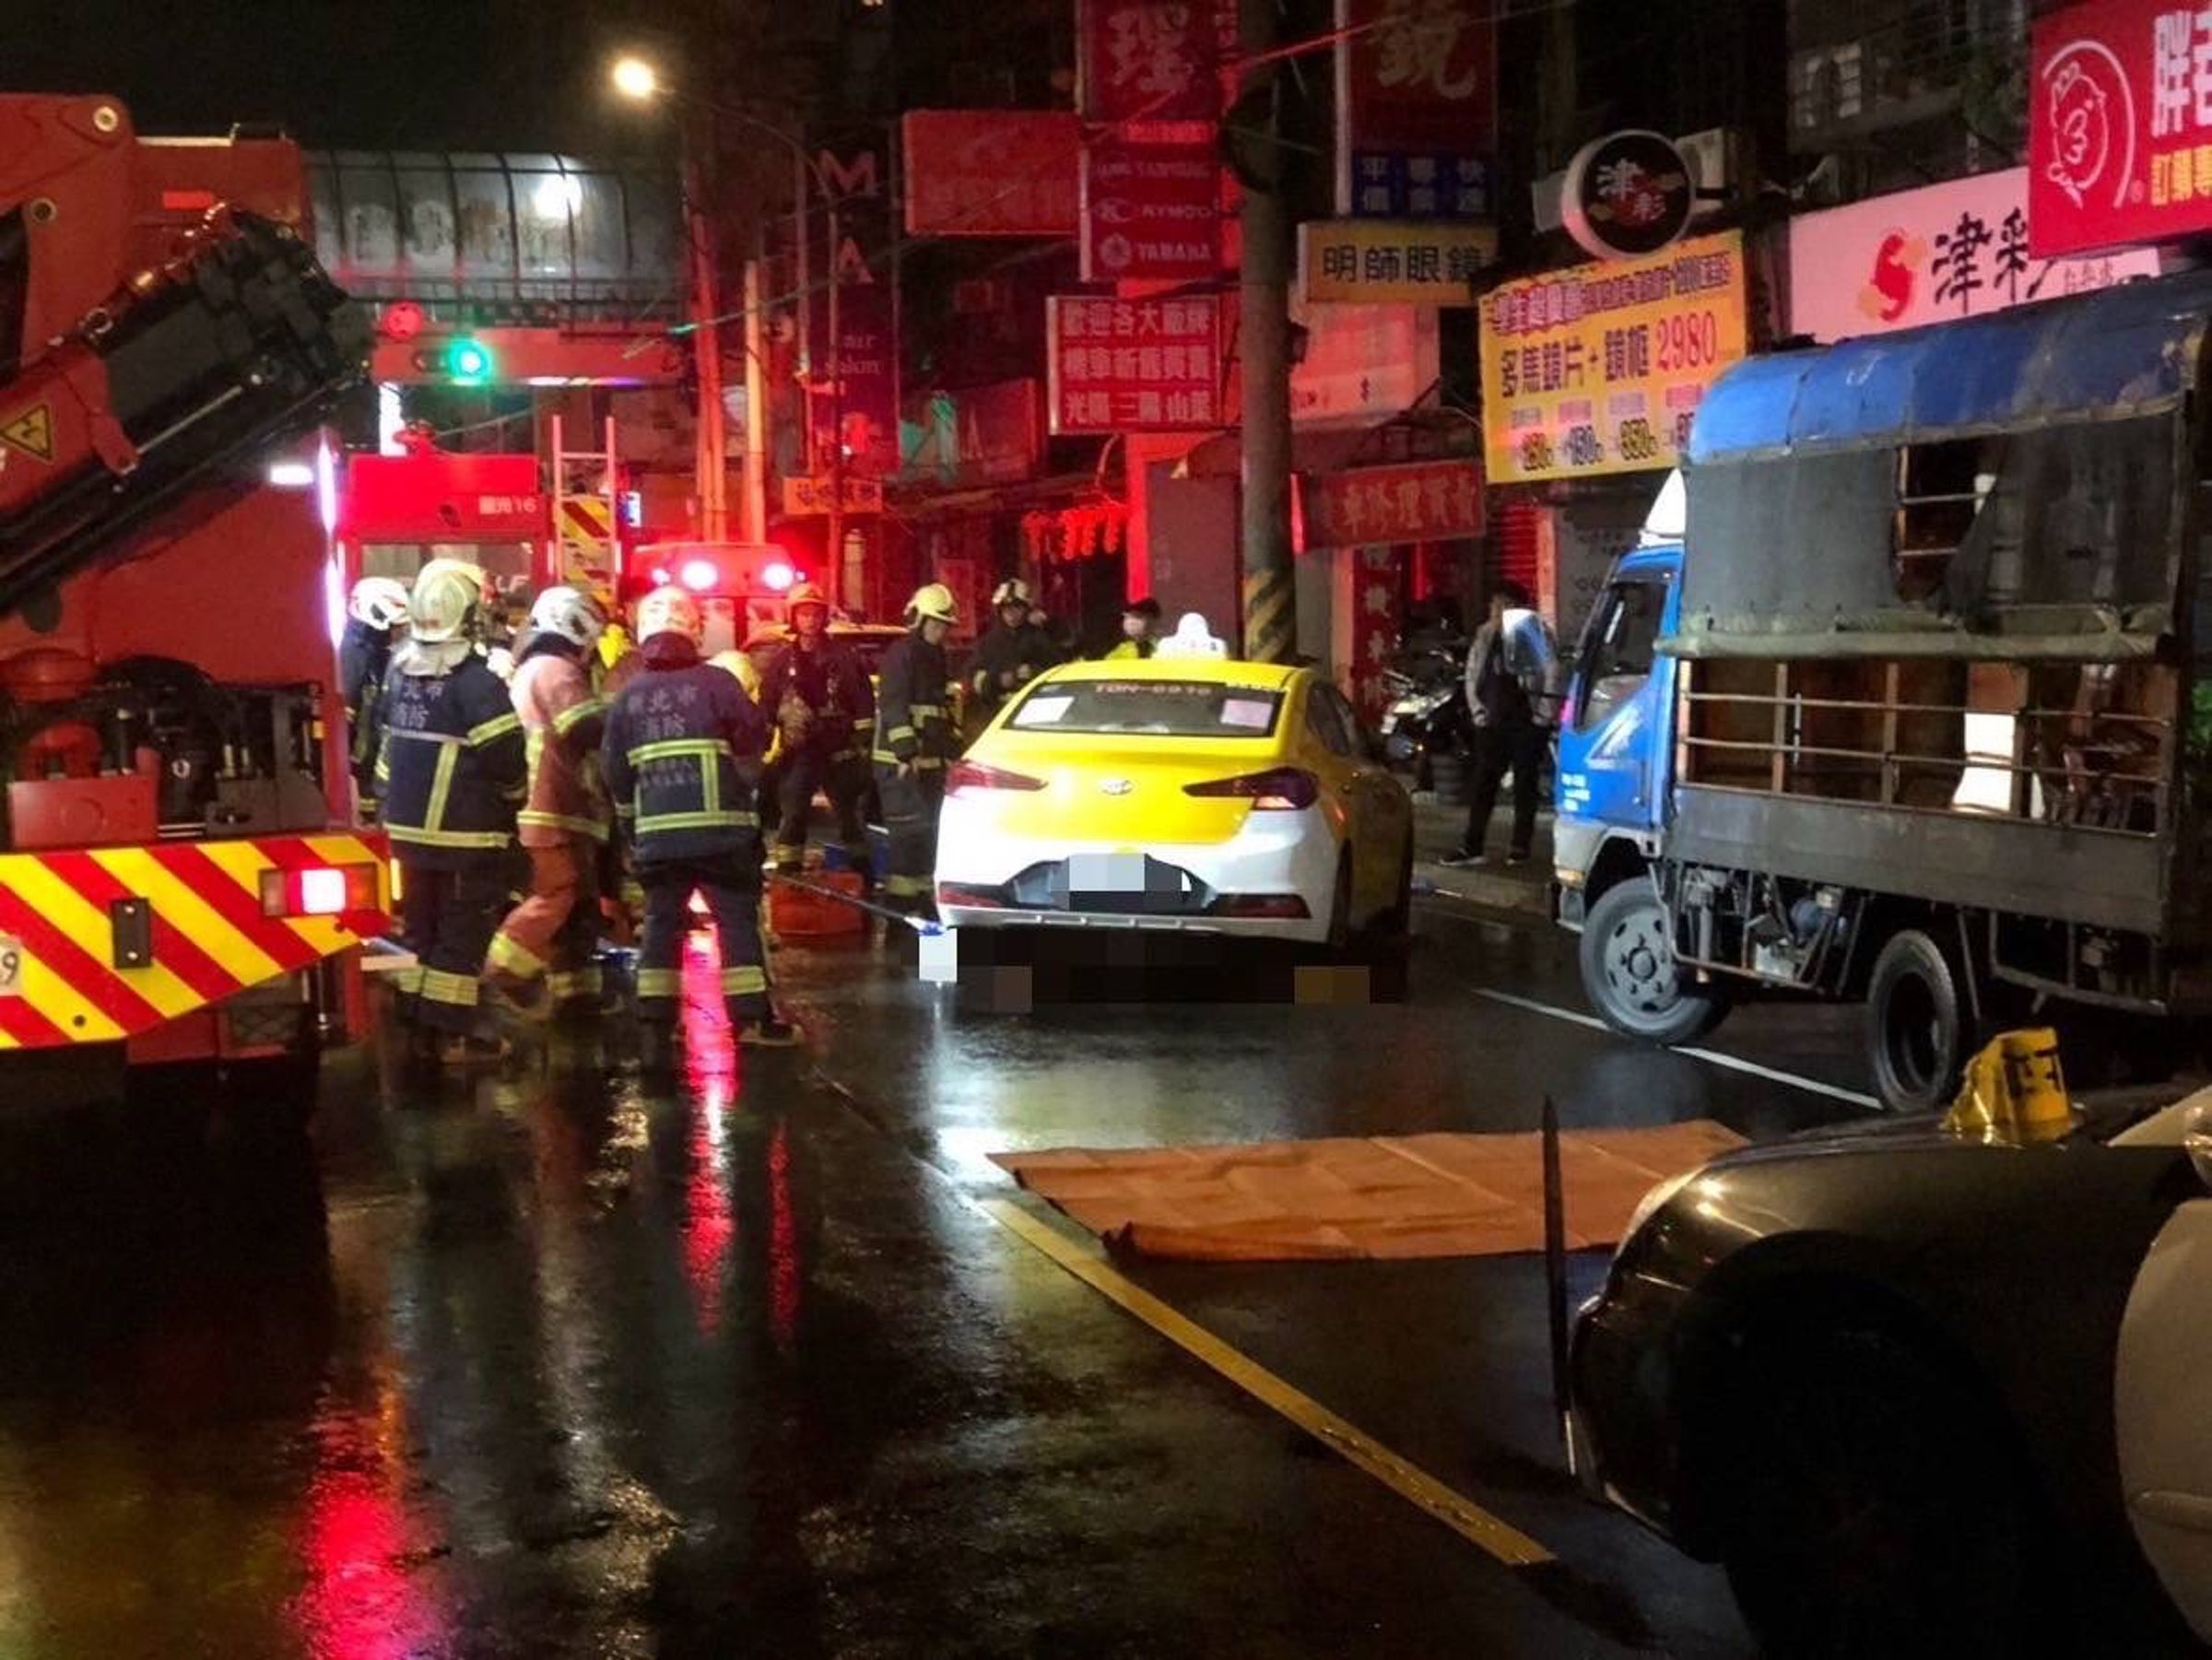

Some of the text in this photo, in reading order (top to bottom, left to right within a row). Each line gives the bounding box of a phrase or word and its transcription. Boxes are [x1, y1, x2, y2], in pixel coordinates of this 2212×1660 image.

[1322, 244, 1484, 284] 明師眼鏡
[1656, 312, 1718, 372] 2980
